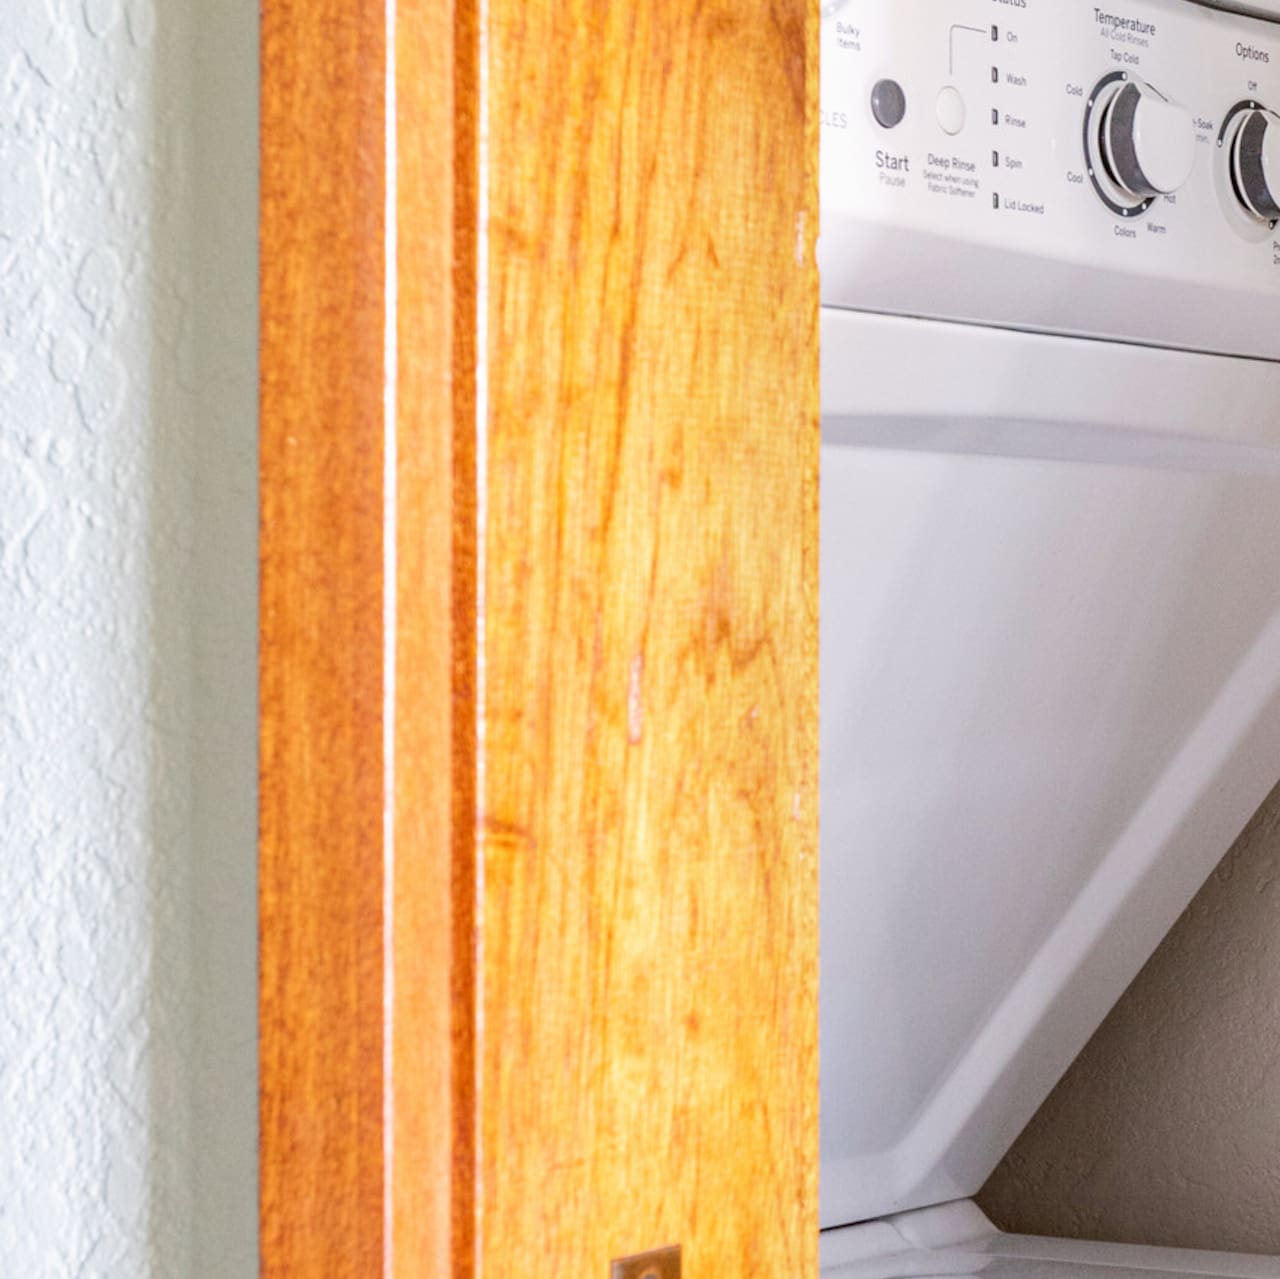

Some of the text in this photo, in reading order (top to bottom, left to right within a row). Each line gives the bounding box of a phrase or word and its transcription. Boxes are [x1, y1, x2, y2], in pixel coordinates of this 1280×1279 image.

[1094, 8, 1156, 36] Temperature
[836, 22, 860, 38] Bulky
[1007, 32, 1018, 43] On
[837, 38, 862, 52] Items
[1100, 28, 1149, 48] All Cold Rinses
[1110, 49, 1140, 65] Tap Cold
[1235, 42, 1270, 63] Options
[1006, 73, 1027, 87] Wash
[1248, 80, 1258, 91] Off
[1066, 83, 1083, 97] Cold
[1005, 114, 1027, 128] Rinse
[875, 150, 909, 172] Start
[928, 153, 976, 172] Deep Rinse
[1005, 157, 1023, 169] Spin
[879, 172, 906, 188] Pause
[923, 169, 944, 182] Select
[944, 173, 961, 184] when
[1067, 172, 1083, 184] Cool
[927, 182, 976, 198] Fabric Softener
[1004, 199, 1045, 214] Lid Locked
[1114, 225, 1136, 238] Colors
[1147, 222, 1166, 234] Warm
